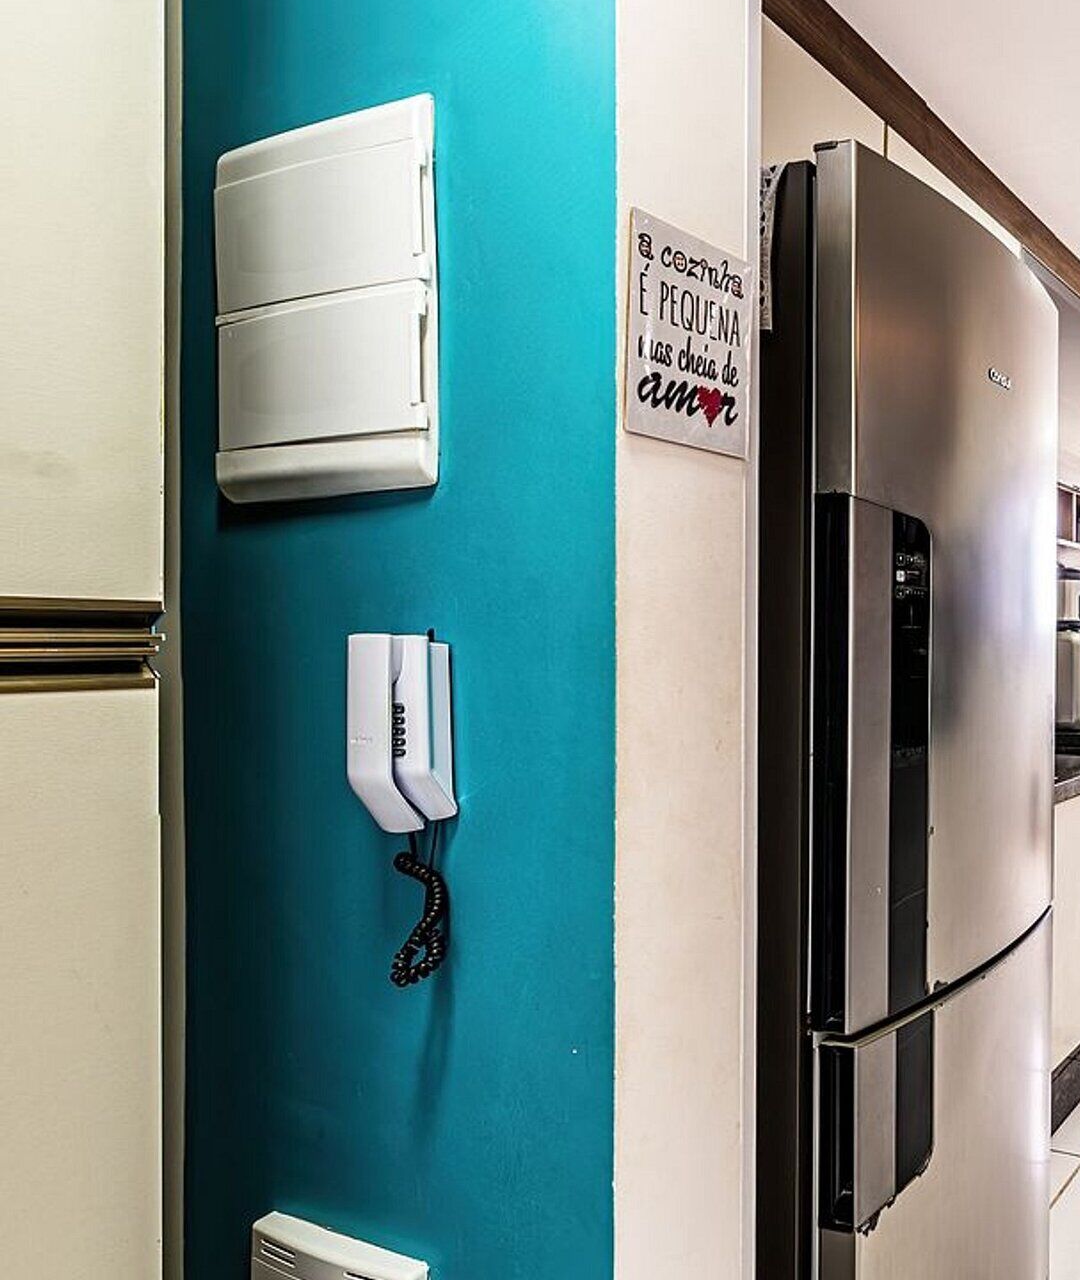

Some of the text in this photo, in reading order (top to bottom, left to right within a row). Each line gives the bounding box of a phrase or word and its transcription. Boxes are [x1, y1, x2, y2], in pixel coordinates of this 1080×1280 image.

[638, 233, 744, 299] a cozinha
[639, 263, 741, 348] É PEQUENA
[678, 336, 718, 382] cheia
[722, 350, 739, 388] de
